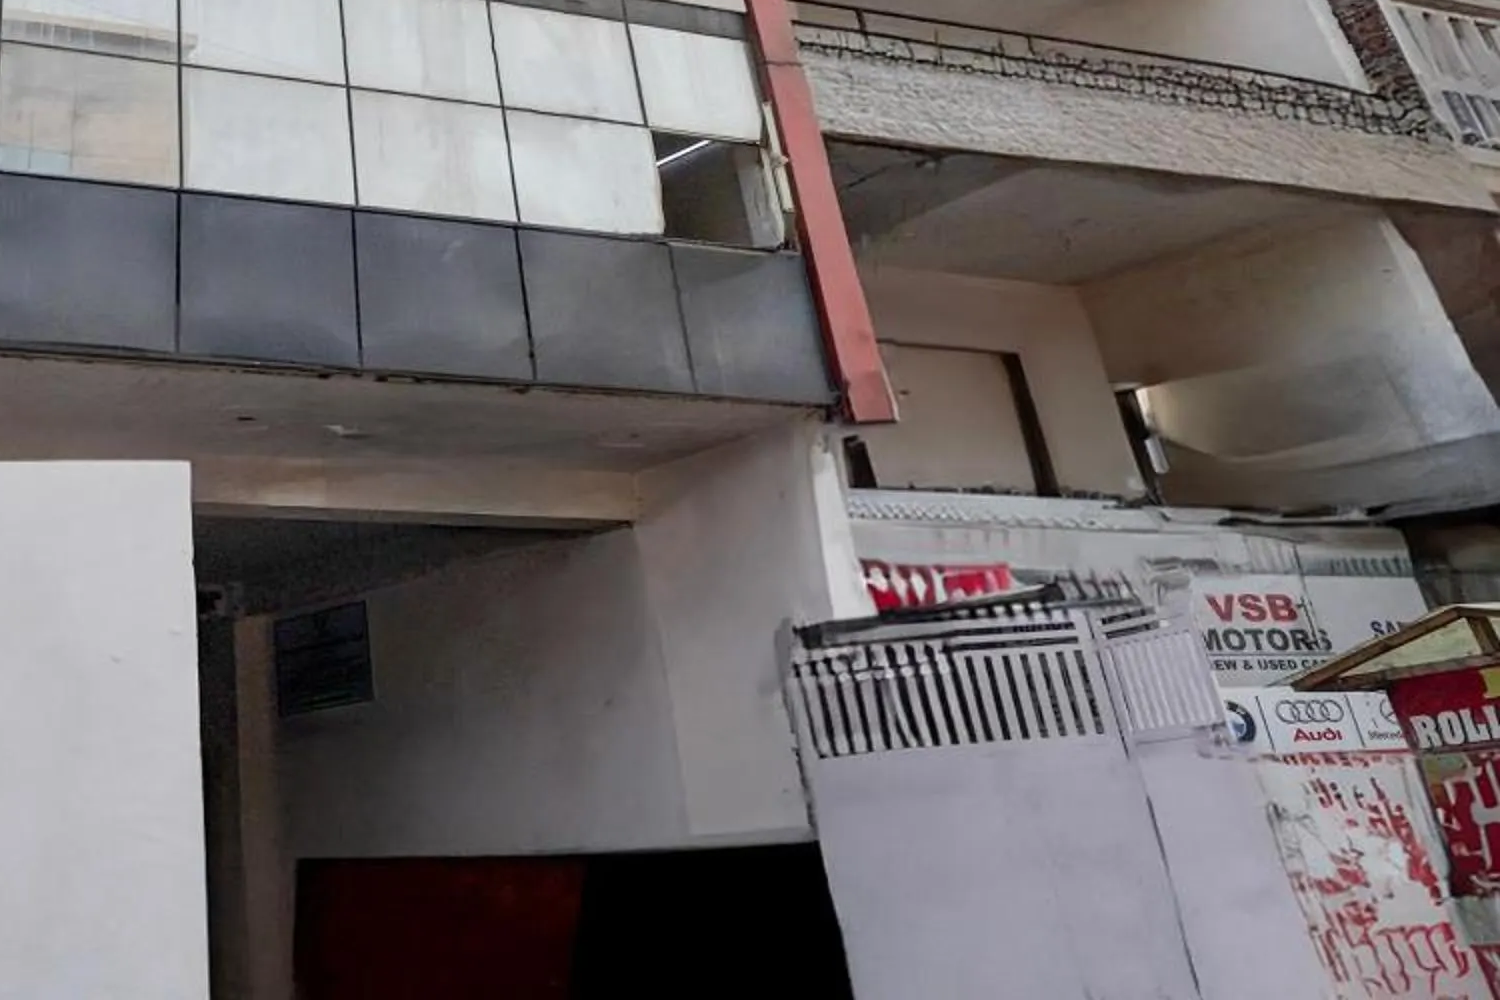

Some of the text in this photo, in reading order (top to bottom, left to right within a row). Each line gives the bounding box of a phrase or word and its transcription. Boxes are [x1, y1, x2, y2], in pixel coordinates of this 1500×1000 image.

[1205, 593, 1299, 623] VSB
[1202, 628, 1333, 651] MOTORS
[1212, 659, 1237, 671] EW
[1243, 659, 1253, 671] &
[1257, 659, 1298, 671] USED
[1293, 727, 1343, 743] Audi
